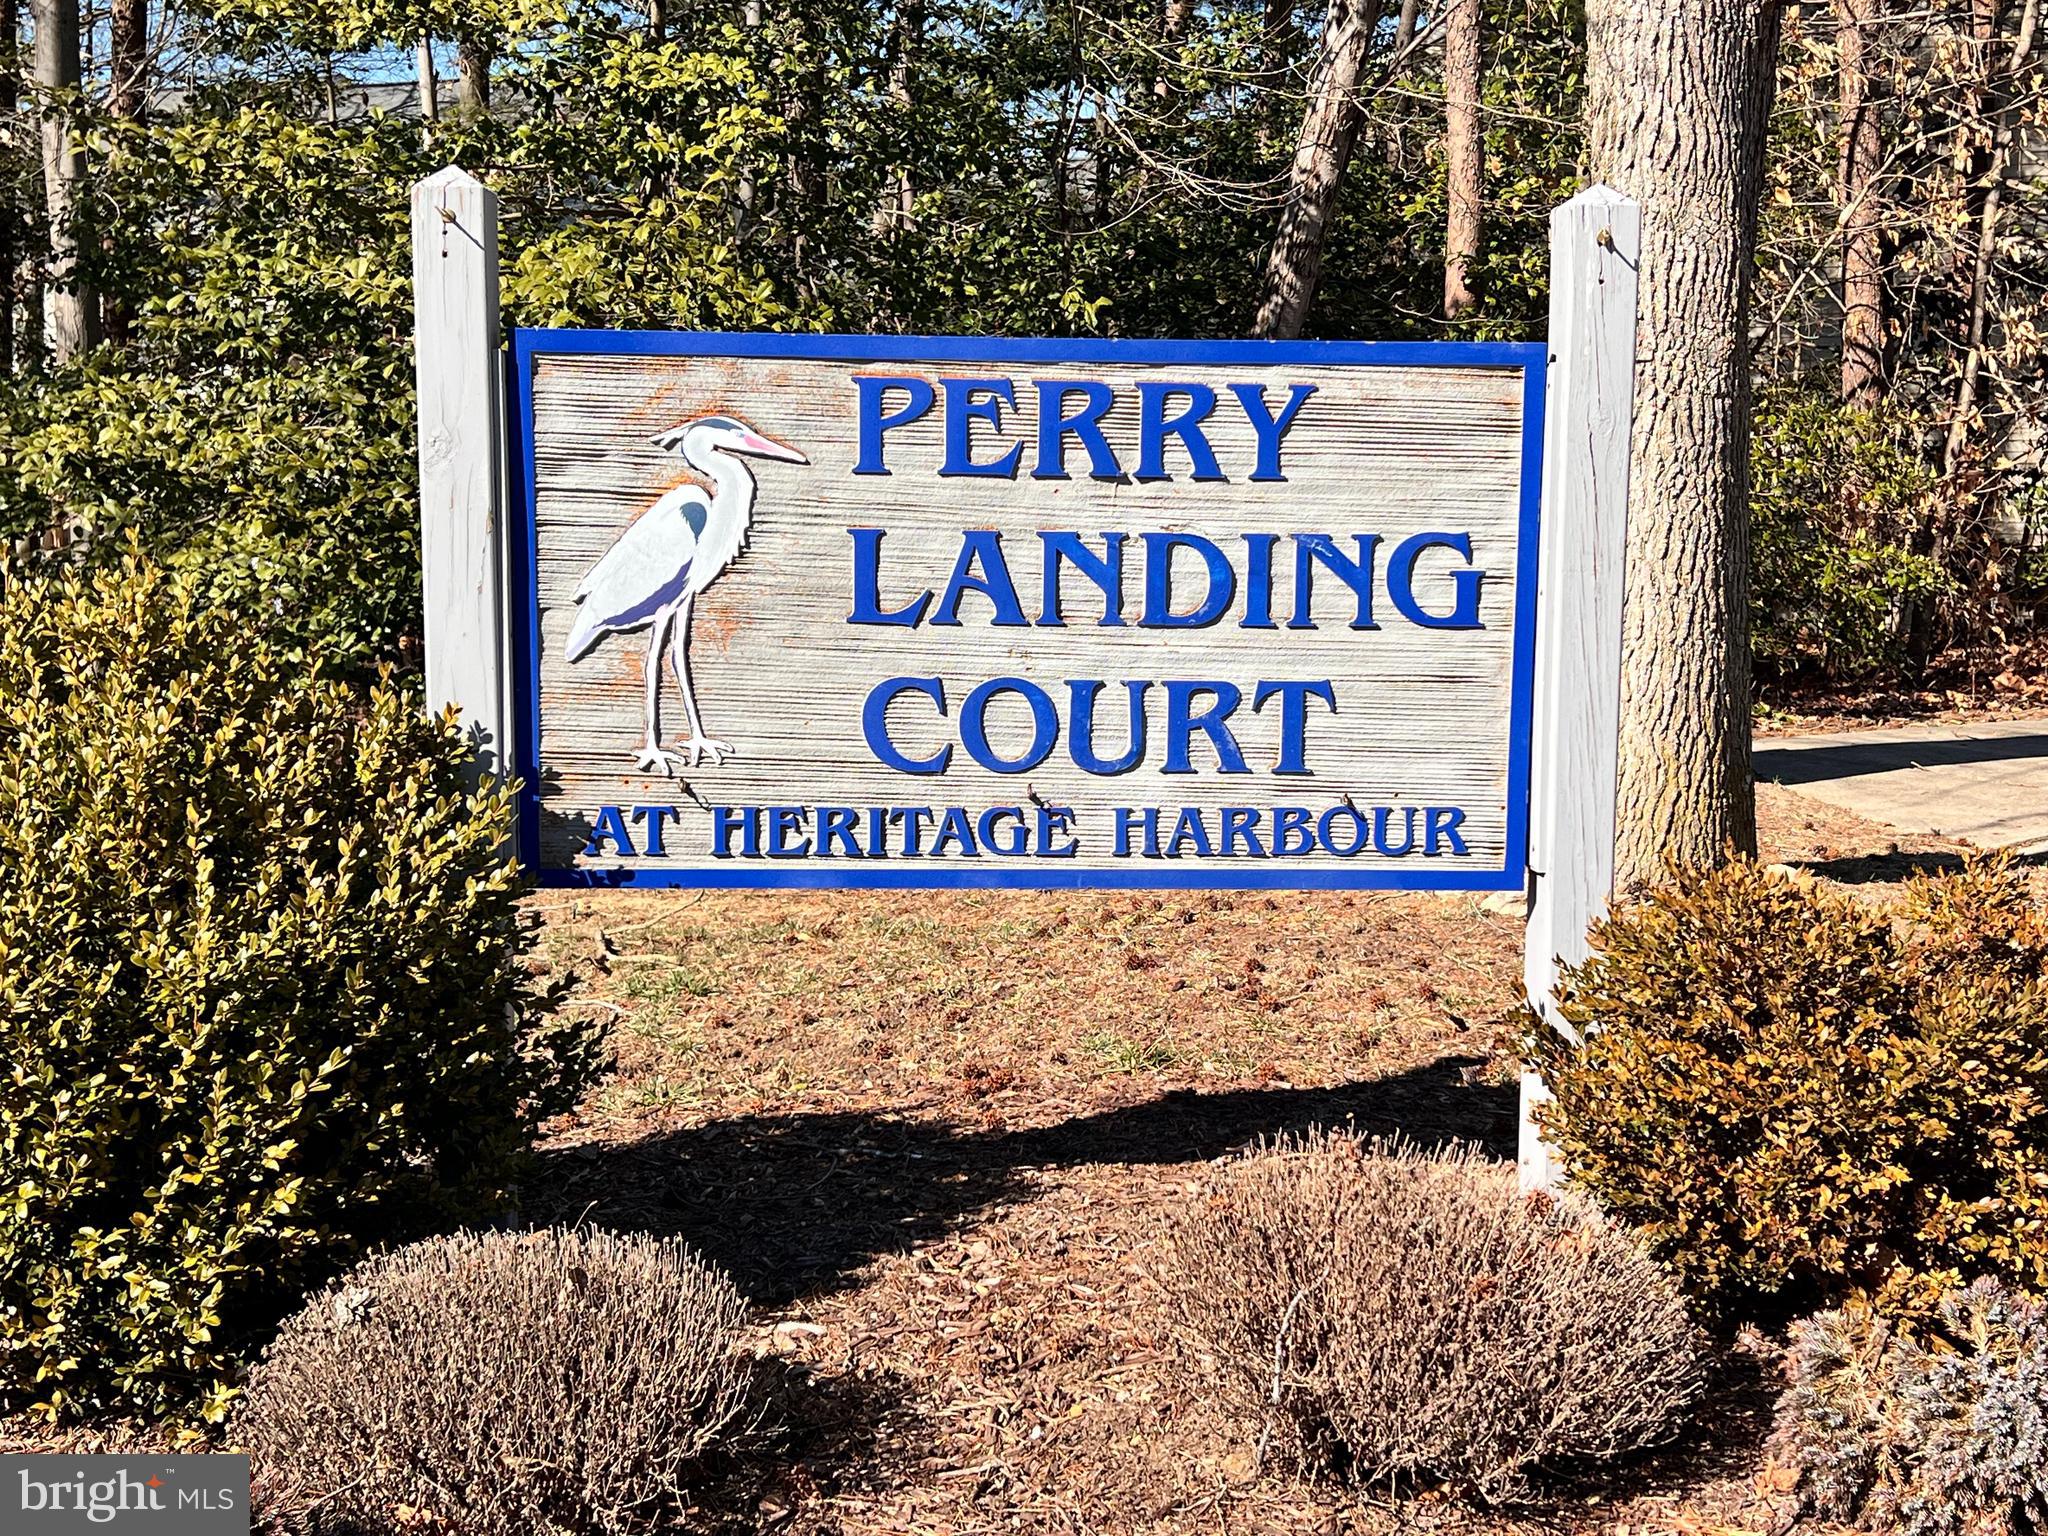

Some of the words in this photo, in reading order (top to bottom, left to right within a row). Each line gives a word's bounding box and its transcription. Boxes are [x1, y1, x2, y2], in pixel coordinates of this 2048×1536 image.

[852, 375, 1317, 481] PERRY
[847, 528, 1485, 629] LANDING
[862, 676, 1336, 775] COURT
[585, 805, 679, 857] AT
[712, 805, 1076, 858] HERITAGE
[1113, 805, 1470, 856] HARBOUR
